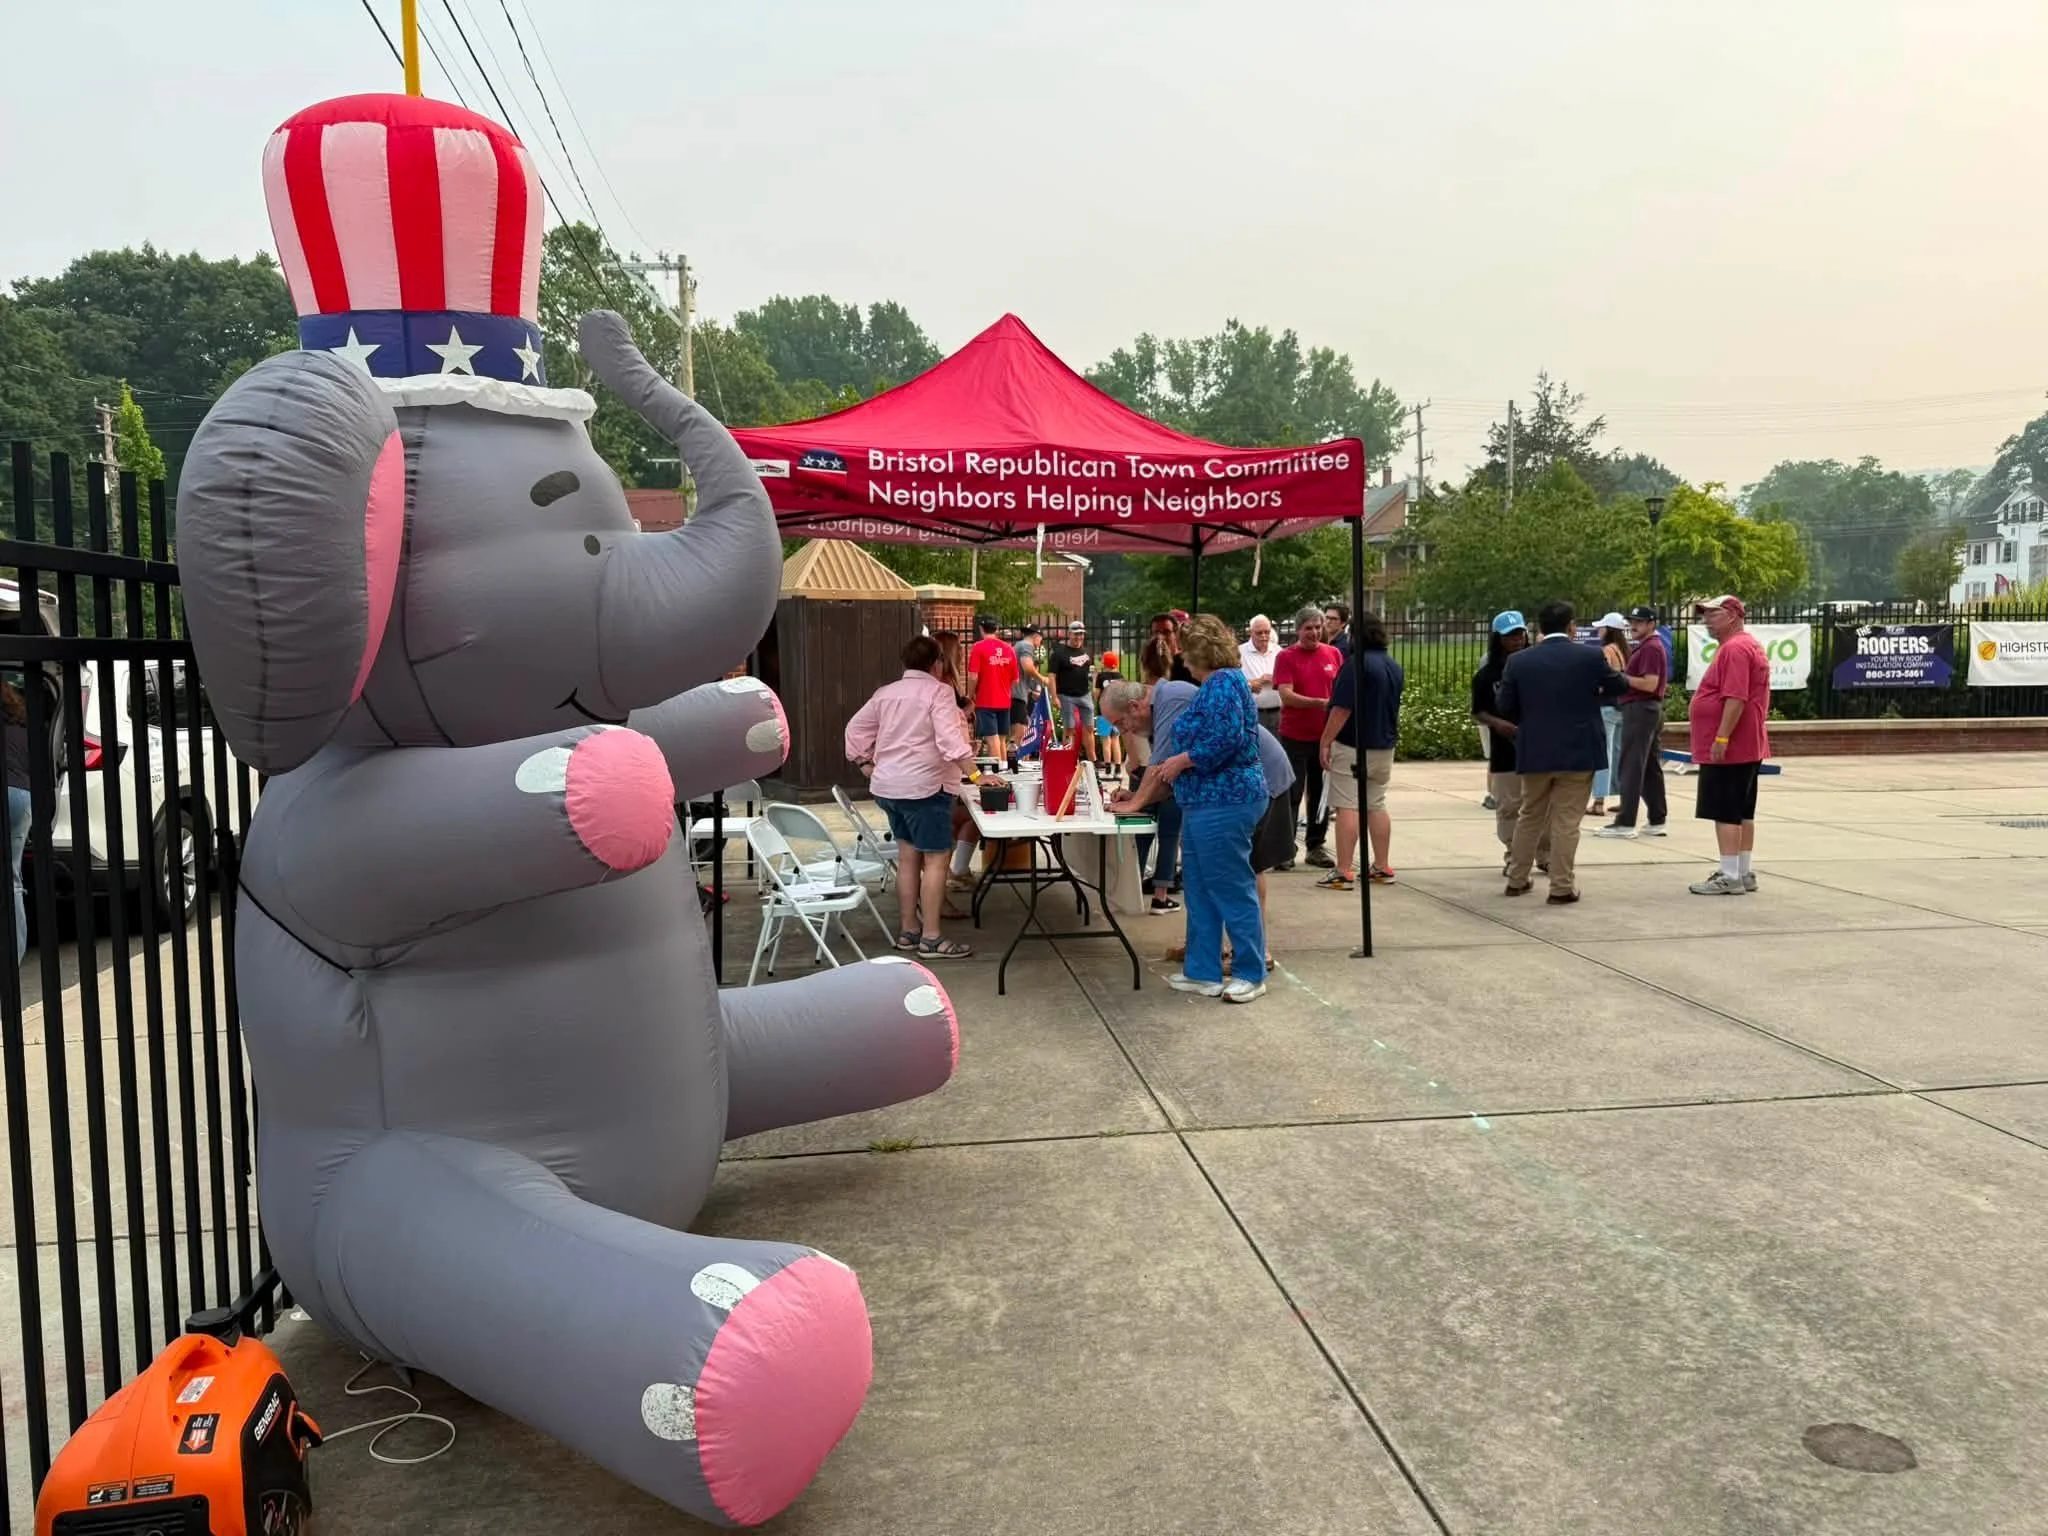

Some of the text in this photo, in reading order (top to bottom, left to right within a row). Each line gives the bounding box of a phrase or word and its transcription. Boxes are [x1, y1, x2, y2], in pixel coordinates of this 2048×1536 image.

[868, 449, 1350, 481] Bristol Republican Town Committee
[868, 480, 1283, 518] Neighbors Helping Neighbors
[1856, 625, 1872, 637] THE
[1857, 636, 1929, 655] ROOFERS
[1870, 655, 1888, 663] YOUR
[1903, 661, 1934, 669] COMPANY
[253, 1391, 280, 1441] GENERAC
